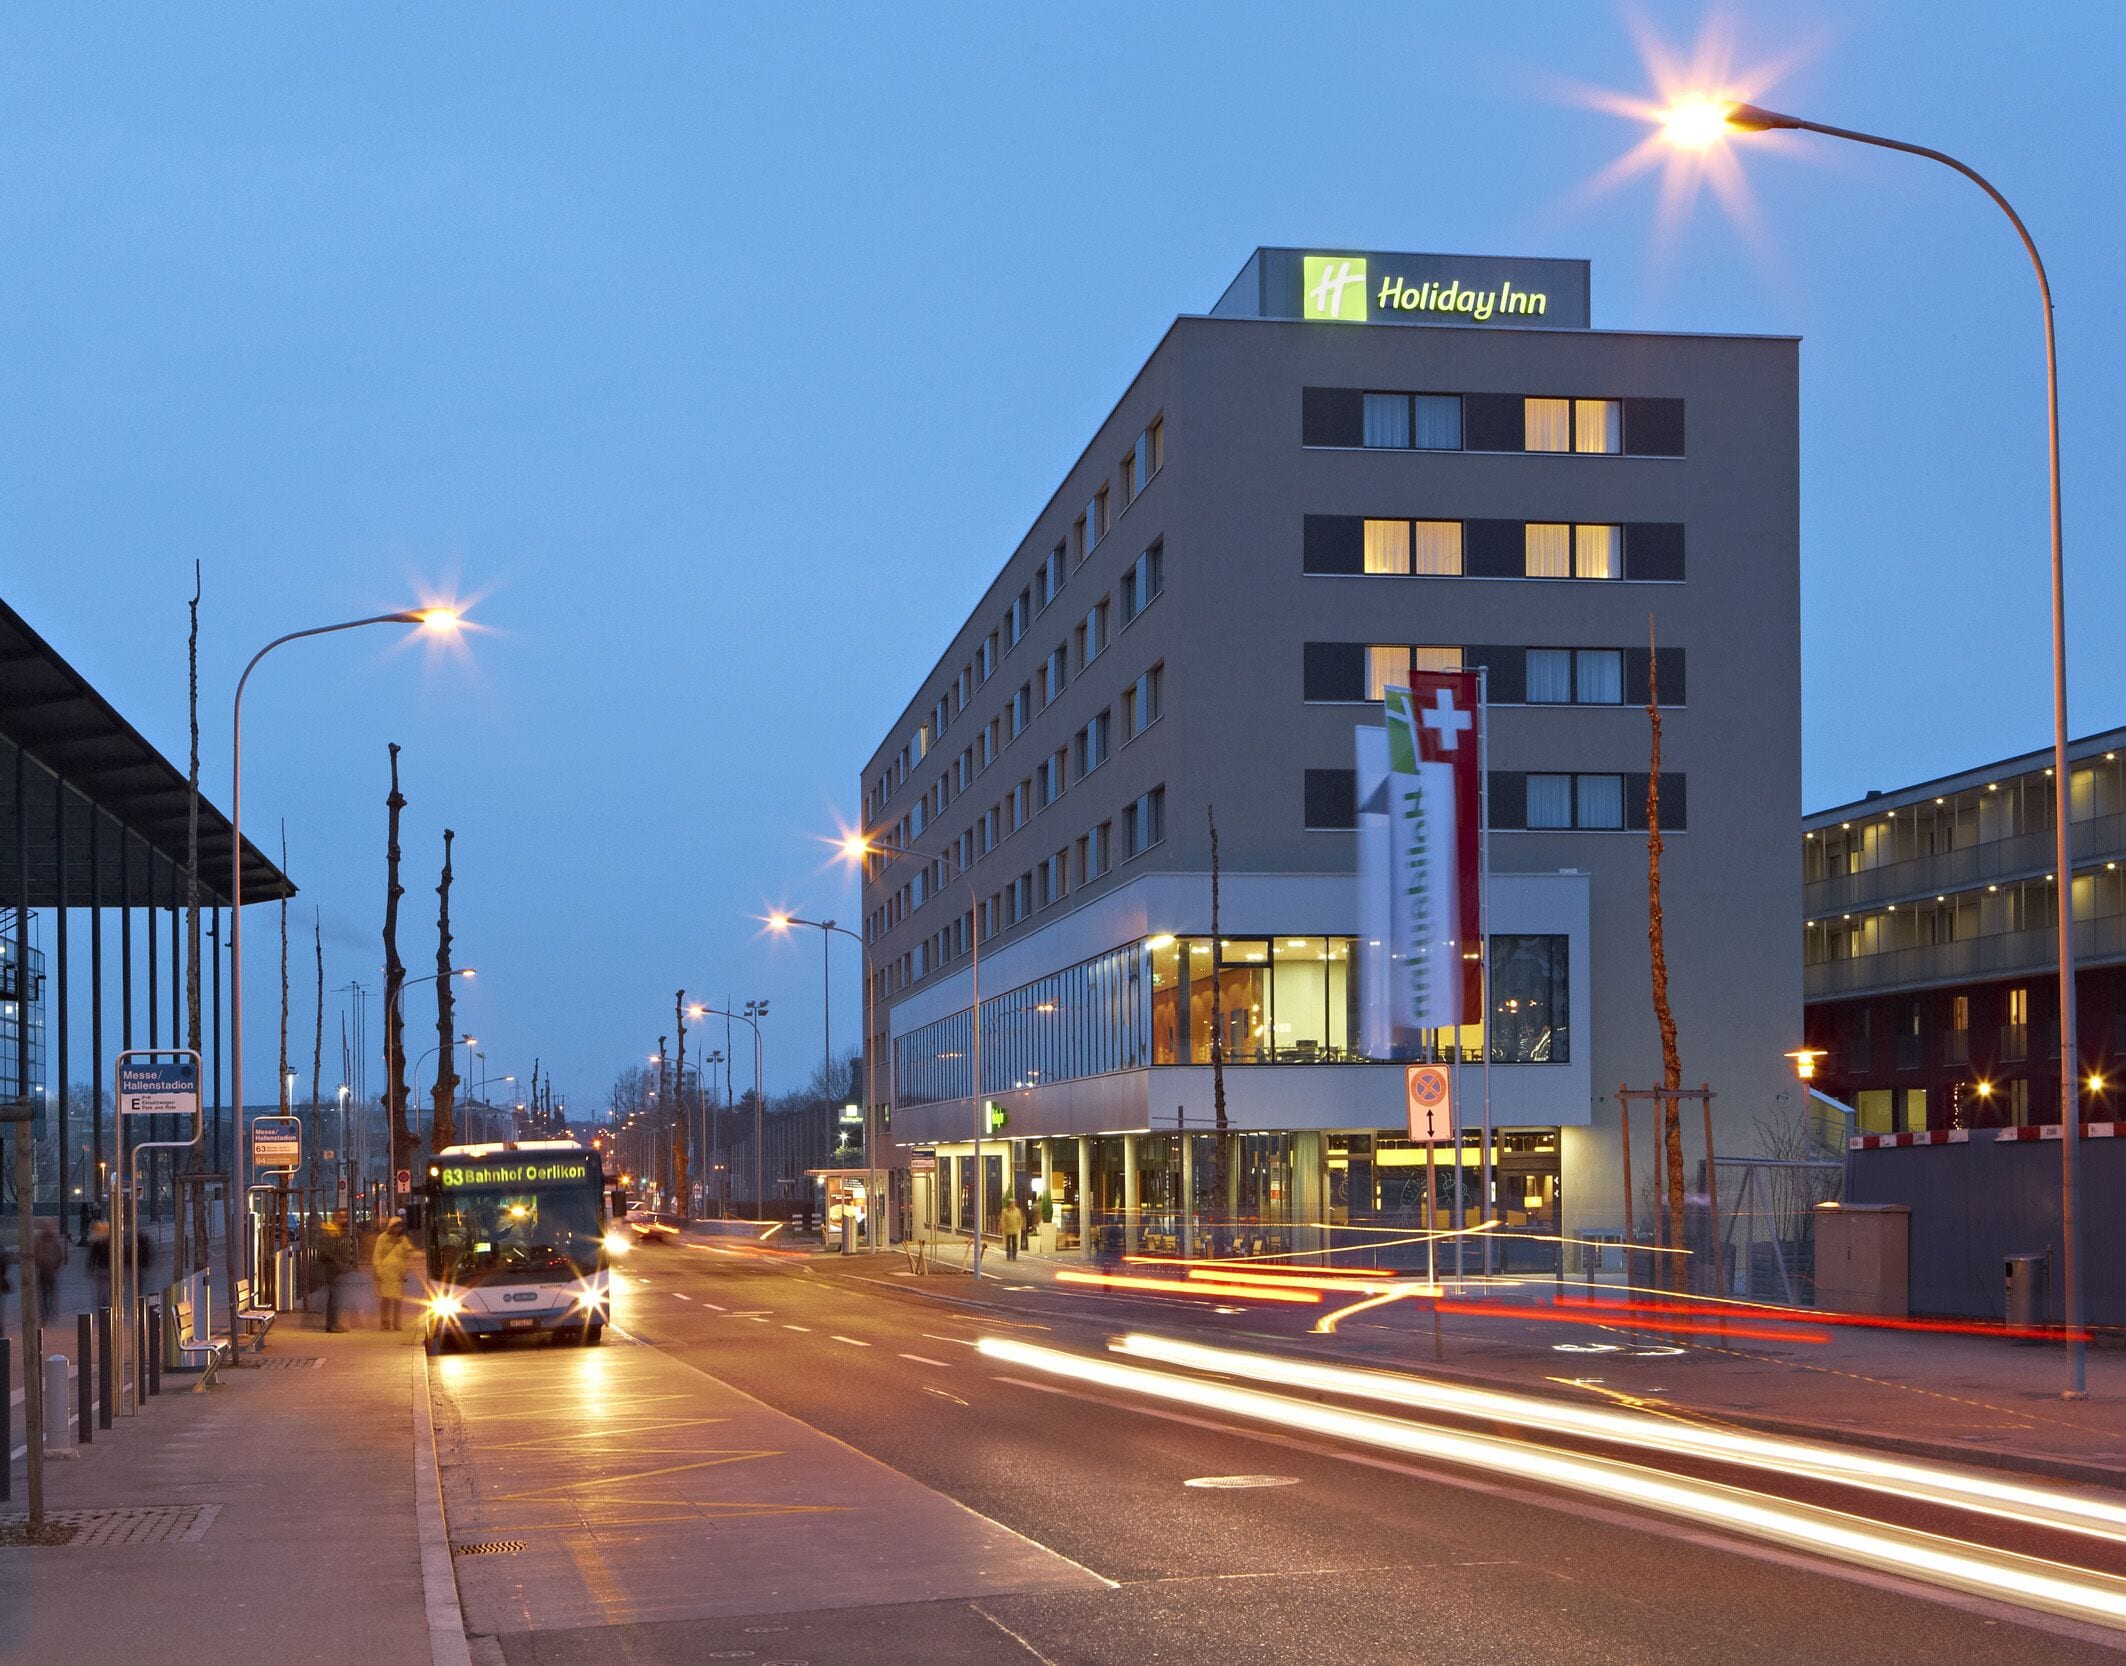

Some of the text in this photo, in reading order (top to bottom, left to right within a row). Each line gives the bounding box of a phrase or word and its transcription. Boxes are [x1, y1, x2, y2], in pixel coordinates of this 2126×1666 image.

[1377, 276, 1547, 321] Holiday Inn
[123, 1070, 163, 1080] Messe/
[123, 1081, 193, 1090] Hallenstadion
[131, 1098, 141, 1110] E
[255, 1145, 266, 1153] 63
[443, 1164, 585, 1186] 63 Bahnhof Oerlikon
